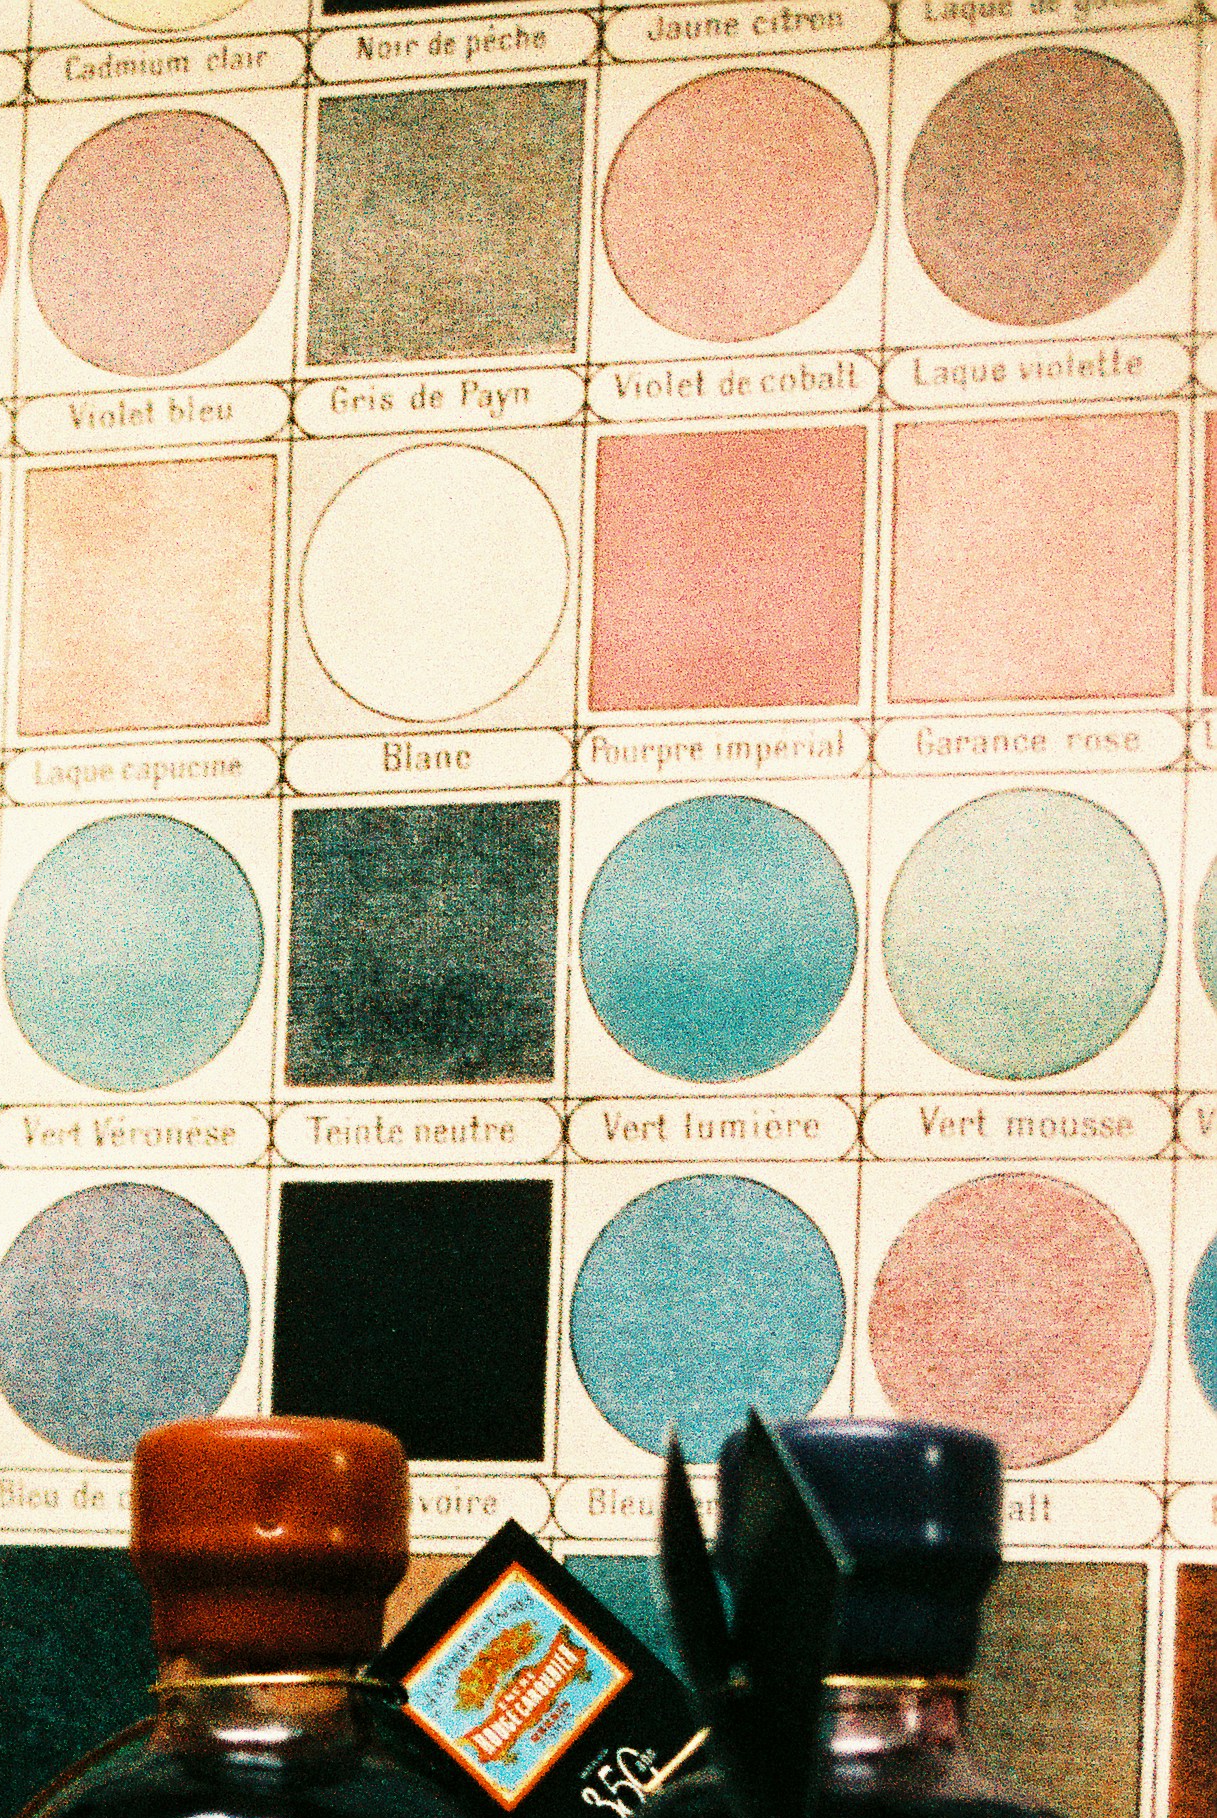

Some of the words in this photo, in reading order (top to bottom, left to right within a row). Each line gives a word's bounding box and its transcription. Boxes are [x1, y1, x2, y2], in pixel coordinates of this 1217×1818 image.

[647, 16, 740, 42] Jaune
[752, 9, 844, 36] citron
[356, 34, 420, 61] Noir
[428, 29, 456, 55] de
[64, 52, 191, 83] Cadmium
[206, 46, 268, 73] clair
[614, 368, 706, 399] Violet
[718, 366, 751, 395] de
[760, 359, 861, 394] cobalt
[912, 355, 1008, 390] Laque
[1018, 346, 1143, 380] violette
[68, 400, 154, 431] Violet
[168, 393, 234, 424] bleu
[329, 385, 395, 415] Gris
[410, 380, 444, 409] de
[460, 379, 531, 418] Payn
[381, 741, 472, 772] Blanc
[590, 735, 703, 770] Pourpre
[916, 726, 1048, 757] Garance
[1066, 730, 1141, 752] rose
[34, 758, 113, 790] Laque
[122, 754, 243, 790] capucine
[22, 1115, 82, 1147] Vert
[306, 1114, 404, 1146] Teinte
[414, 1114, 516, 1144] neutre
[602, 1111, 668, 1142] Vert
[919, 1105, 988, 1137] Vert
[1005, 1114, 1135, 1139] mousse
[417, 1485, 499, 1517] voire
[587, 1487, 657, 1518] Bleu
